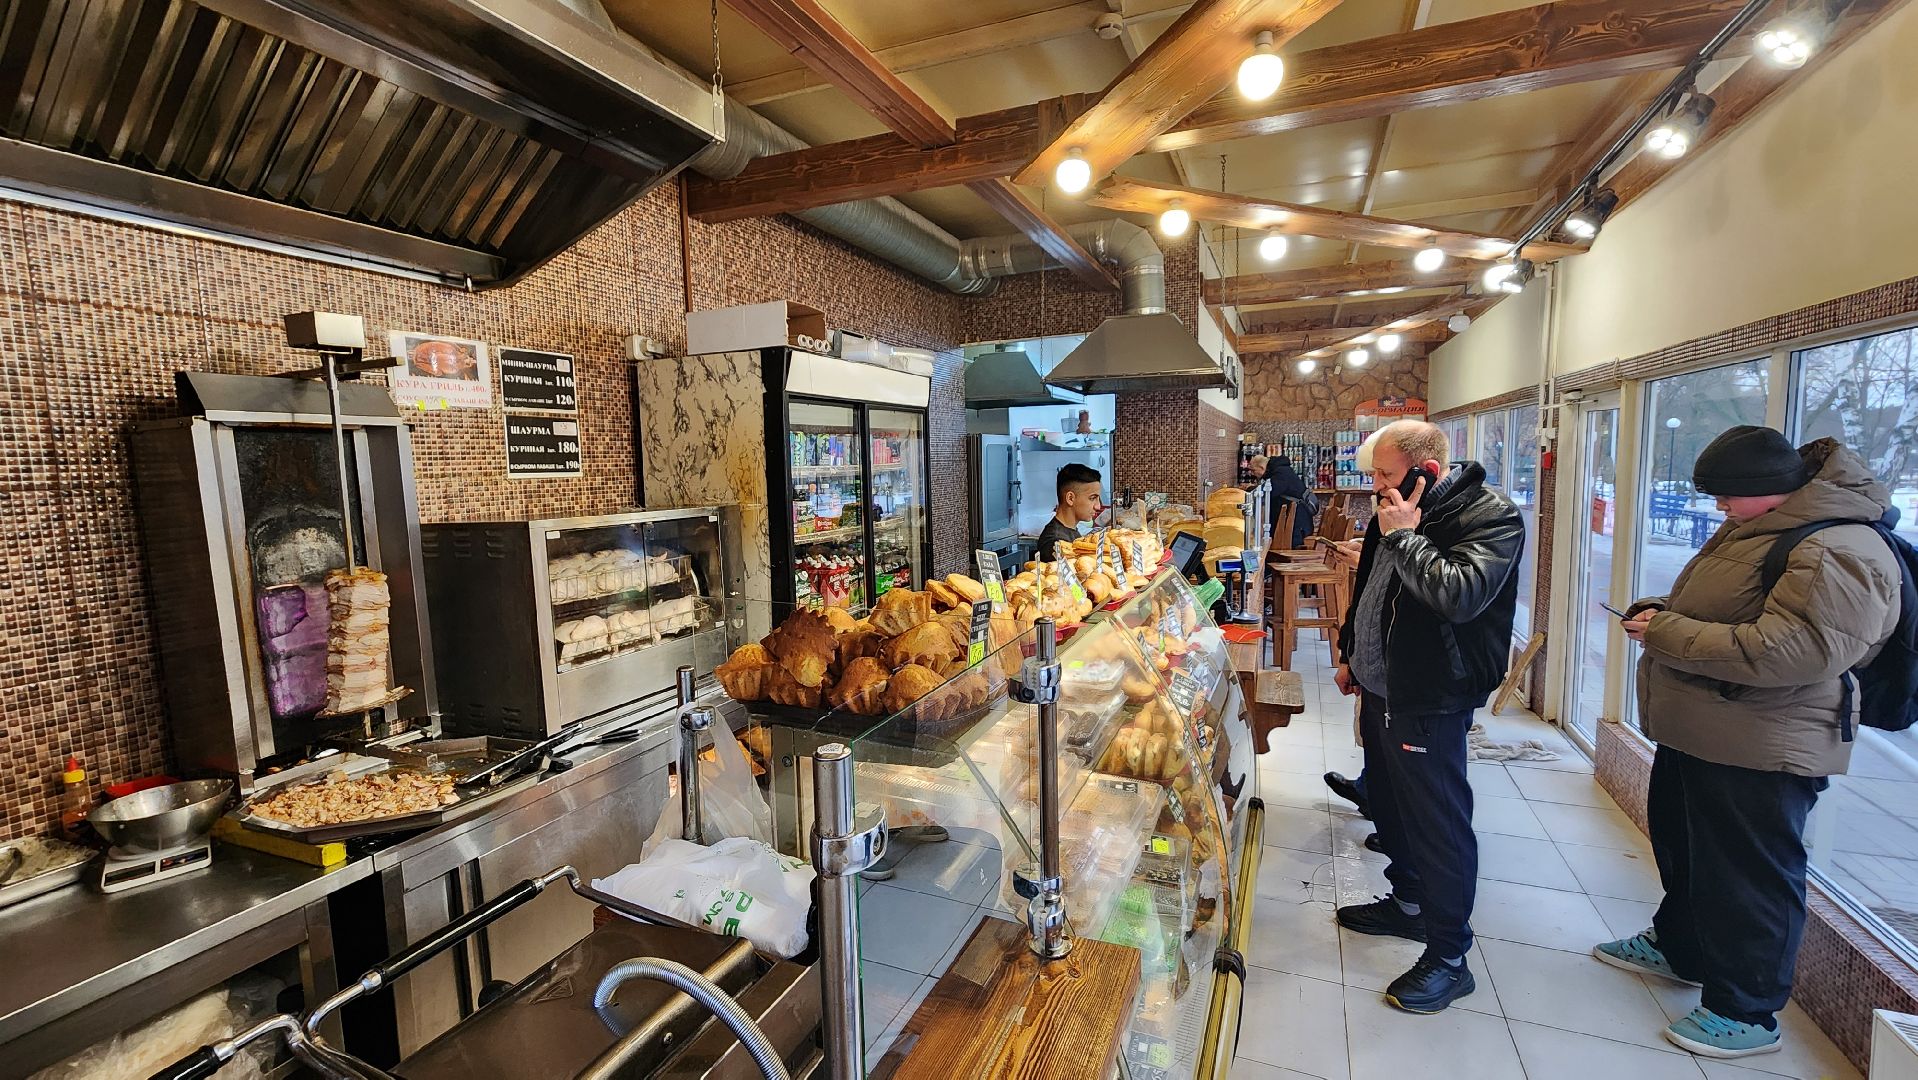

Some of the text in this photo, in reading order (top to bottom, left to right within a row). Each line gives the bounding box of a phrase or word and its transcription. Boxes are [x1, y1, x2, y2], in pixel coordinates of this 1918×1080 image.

[501, 359, 557, 371] МИНИ-ШАУРМА
[504, 374, 543, 385] КУРИНАЯ
[396, 379, 427, 389] КУРА
[430, 381, 464, 392] ГРИЛЬ
[510, 425, 551, 435] ШАУРМА
[510, 445, 545, 453] КУРИНАЯ
